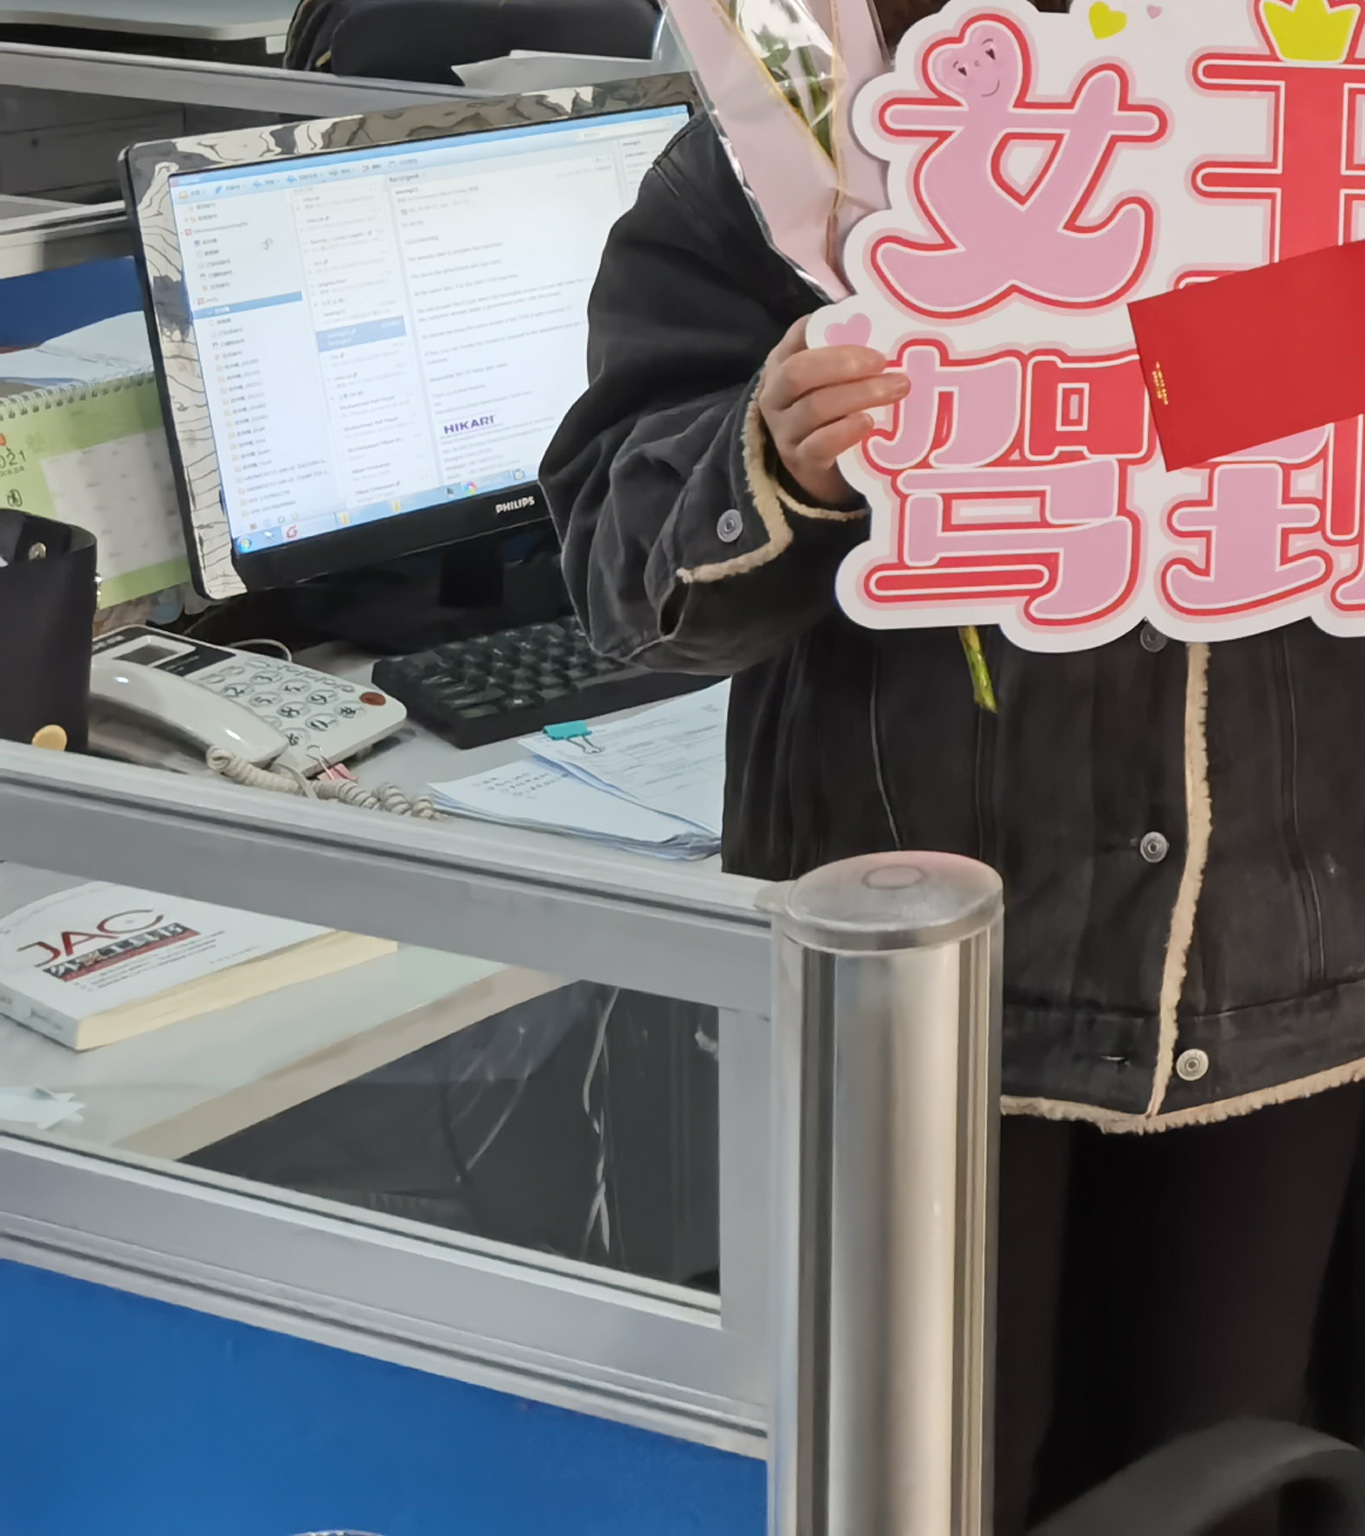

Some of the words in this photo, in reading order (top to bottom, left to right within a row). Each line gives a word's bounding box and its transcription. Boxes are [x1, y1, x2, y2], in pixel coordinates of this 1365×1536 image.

[443, 414, 496, 435] HIKARI
[494, 495, 536, 514] PHILIPS
[16, 908, 165, 968] JAC
